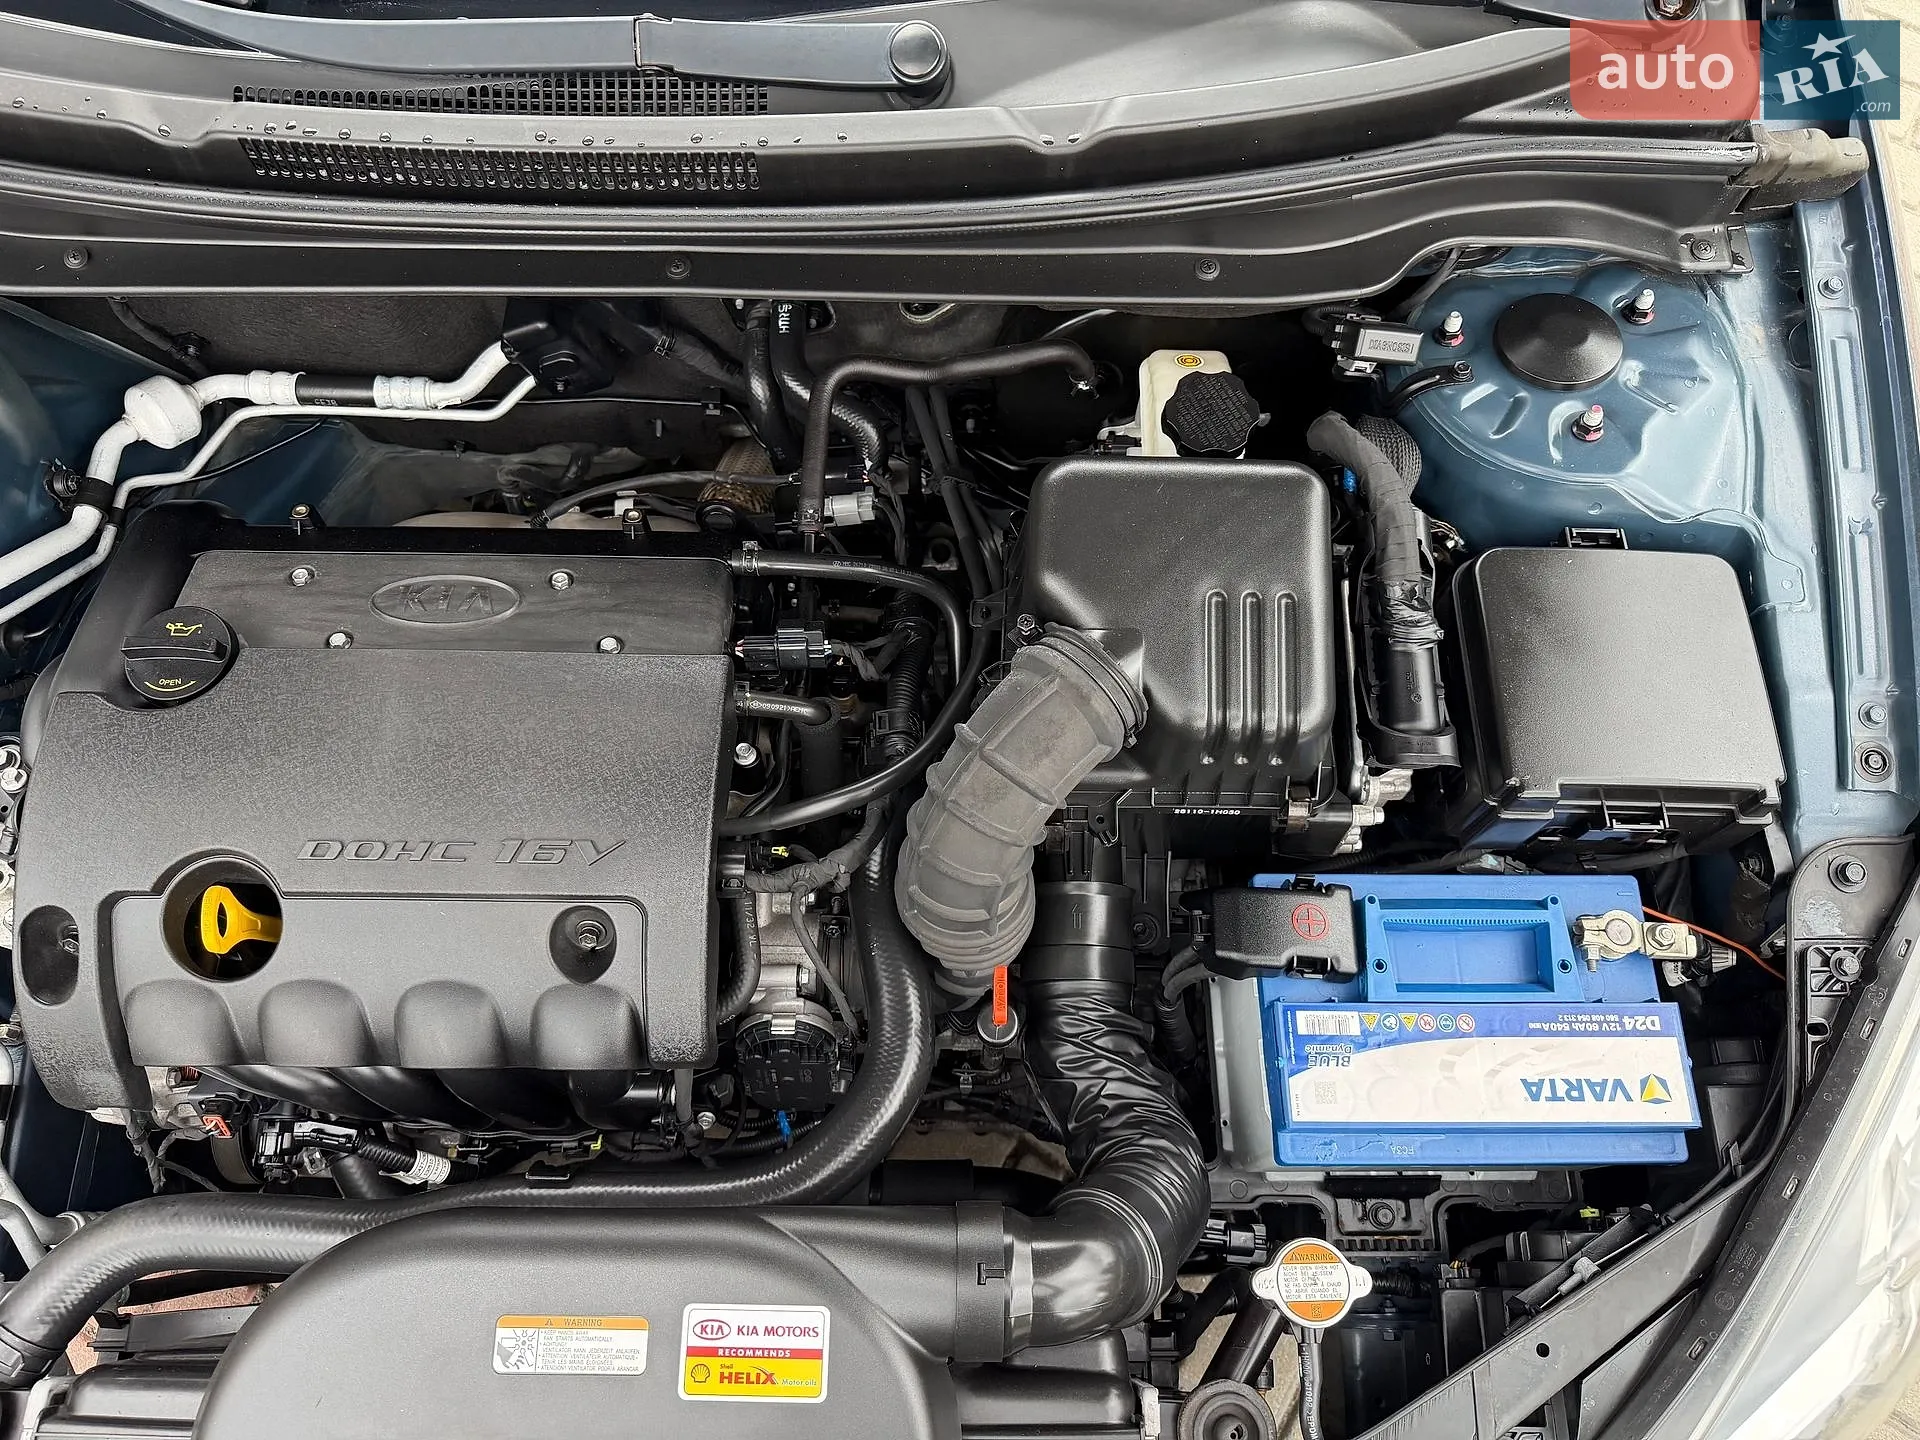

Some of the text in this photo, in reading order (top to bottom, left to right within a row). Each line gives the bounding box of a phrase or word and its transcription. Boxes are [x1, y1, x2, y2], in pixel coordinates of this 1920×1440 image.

[400, 584, 494, 614] KIA
[297, 839, 626, 866] DOHC 16V
[1572, 1022, 1598, 1031] 60Ah
[1602, 1022, 1621, 1031] 12V
[1622, 1015, 1661, 1030] D24
[1305, 1044, 1352, 1054] Dynamic
[1309, 1055, 1351, 1067] BLUE
[1520, 1078, 1633, 1102] VARTA
[564, 1318, 602, 1327] WARNING
[700, 1324, 725, 1336] KIA
[737, 1325, 819, 1337] KIA MOTORS
[718, 1349, 791, 1357] RECOMMENDS
[719, 1372, 776, 1385] HELIX
